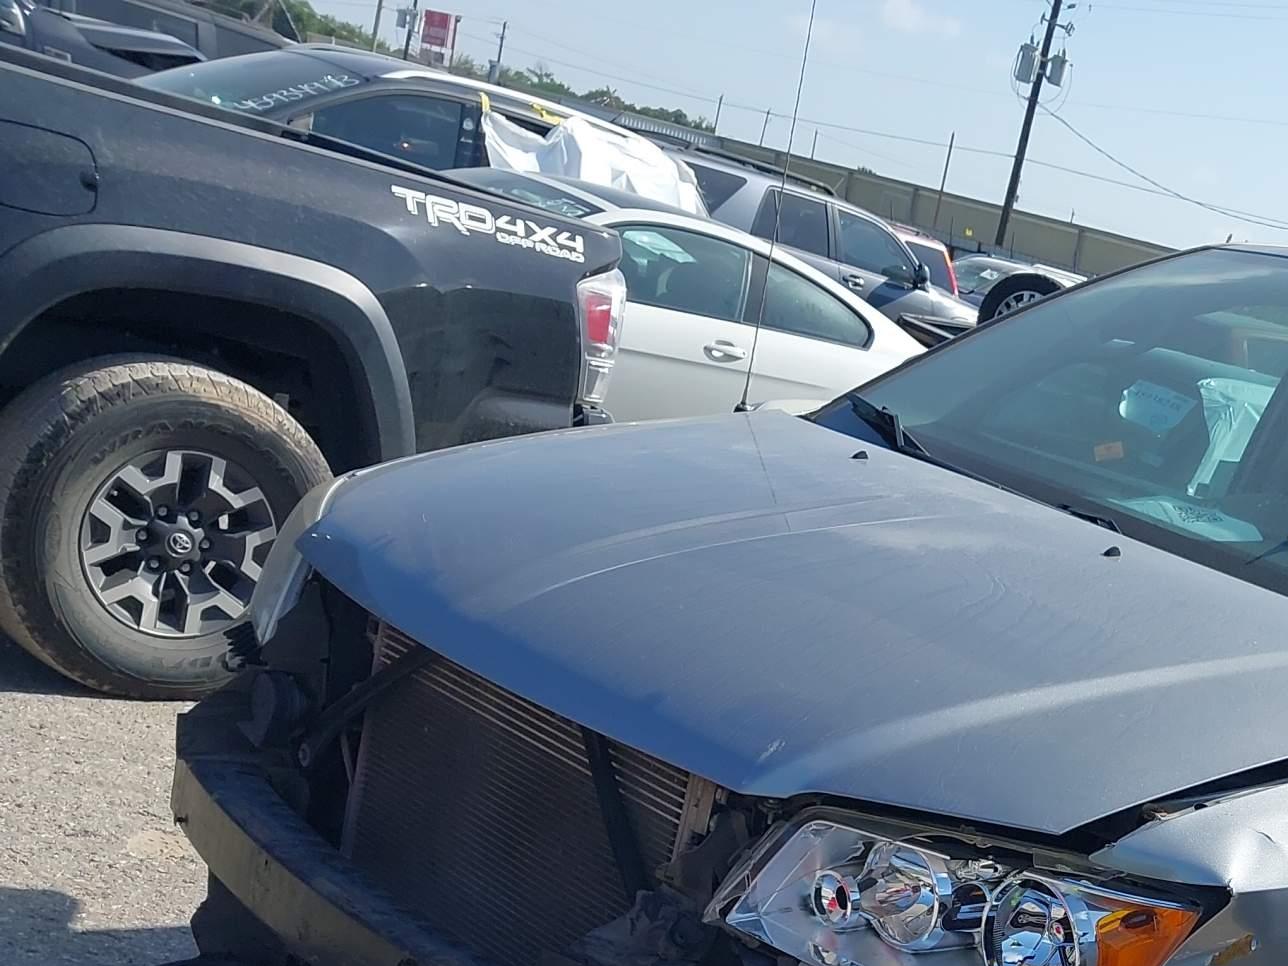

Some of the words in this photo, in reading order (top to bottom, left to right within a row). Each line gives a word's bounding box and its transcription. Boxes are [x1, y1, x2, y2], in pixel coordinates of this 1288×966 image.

[391, 185, 496, 236] TRD
[496, 232, 535, 249] OFF
[536, 241, 585, 263] ROAD
